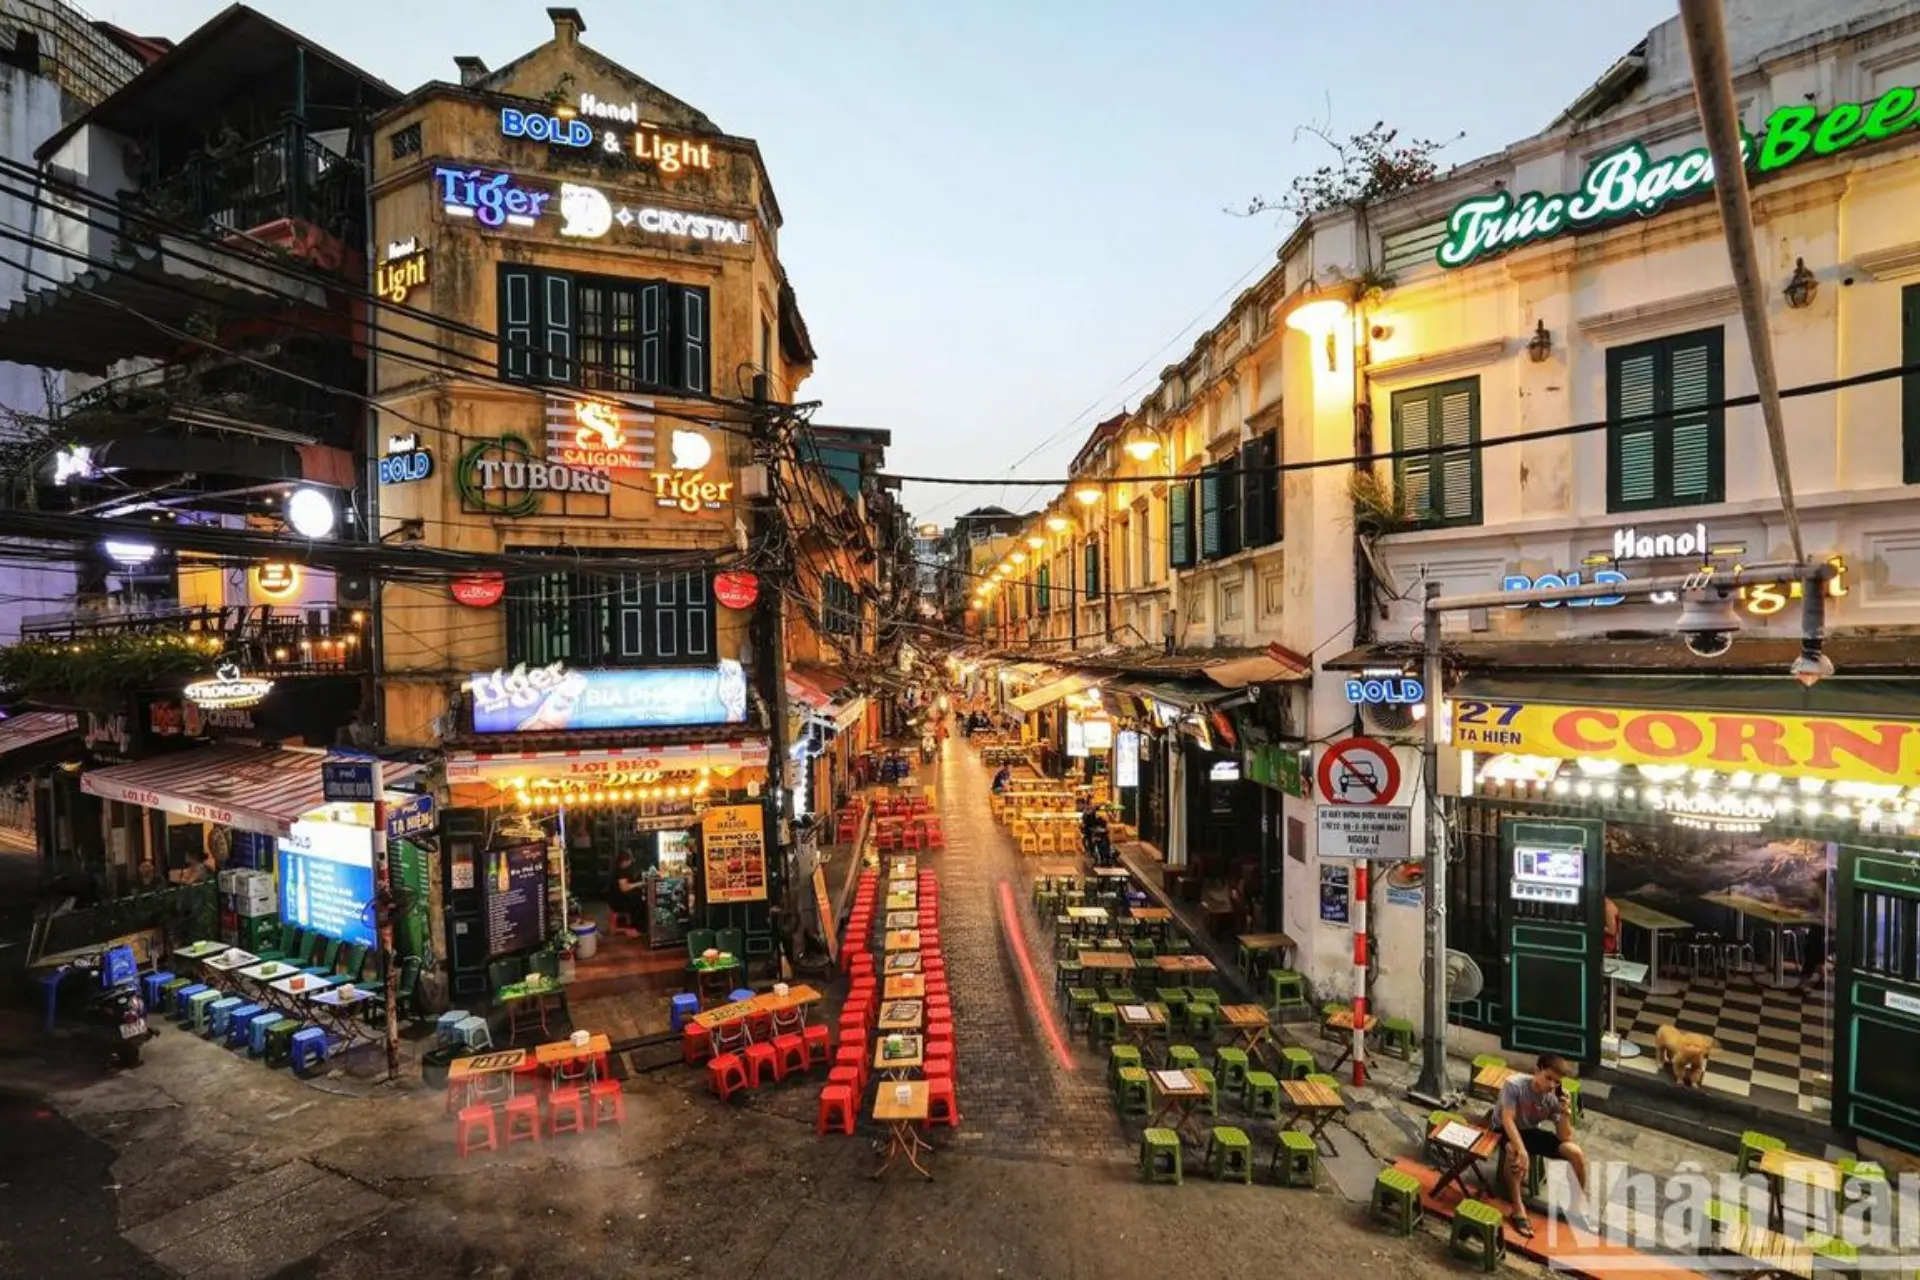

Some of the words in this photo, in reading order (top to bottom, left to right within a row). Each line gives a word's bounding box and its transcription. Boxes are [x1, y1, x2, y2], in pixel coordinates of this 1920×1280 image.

[580, 93, 638, 123] Hanoi
[501, 107, 593, 148] BOLD
[603, 131, 621, 154] &
[634, 131, 712, 171] Light
[1441, 188, 1565, 264] Trúc
[1567, 145, 1748, 218] Bạc
[1759, 86, 1920, 172] Bee
[435, 166, 550, 226] Tiger
[637, 207, 753, 245] CRYSTAL
[377, 254, 426, 303] Light
[378, 452, 430, 484] BOLD
[477, 459, 611, 494] TUBORG
[563, 450, 633, 467] SAIGON
[650, 471, 734, 512] Tiger
[1613, 523, 1706, 560] Hanoi
[1345, 678, 1424, 703] BOLD
[1458, 701, 1525, 725] 27
[1459, 728, 1477, 745] TẠ
[1482, 729, 1522, 745] HIỆN
[1552, 707, 1920, 776] CORN
